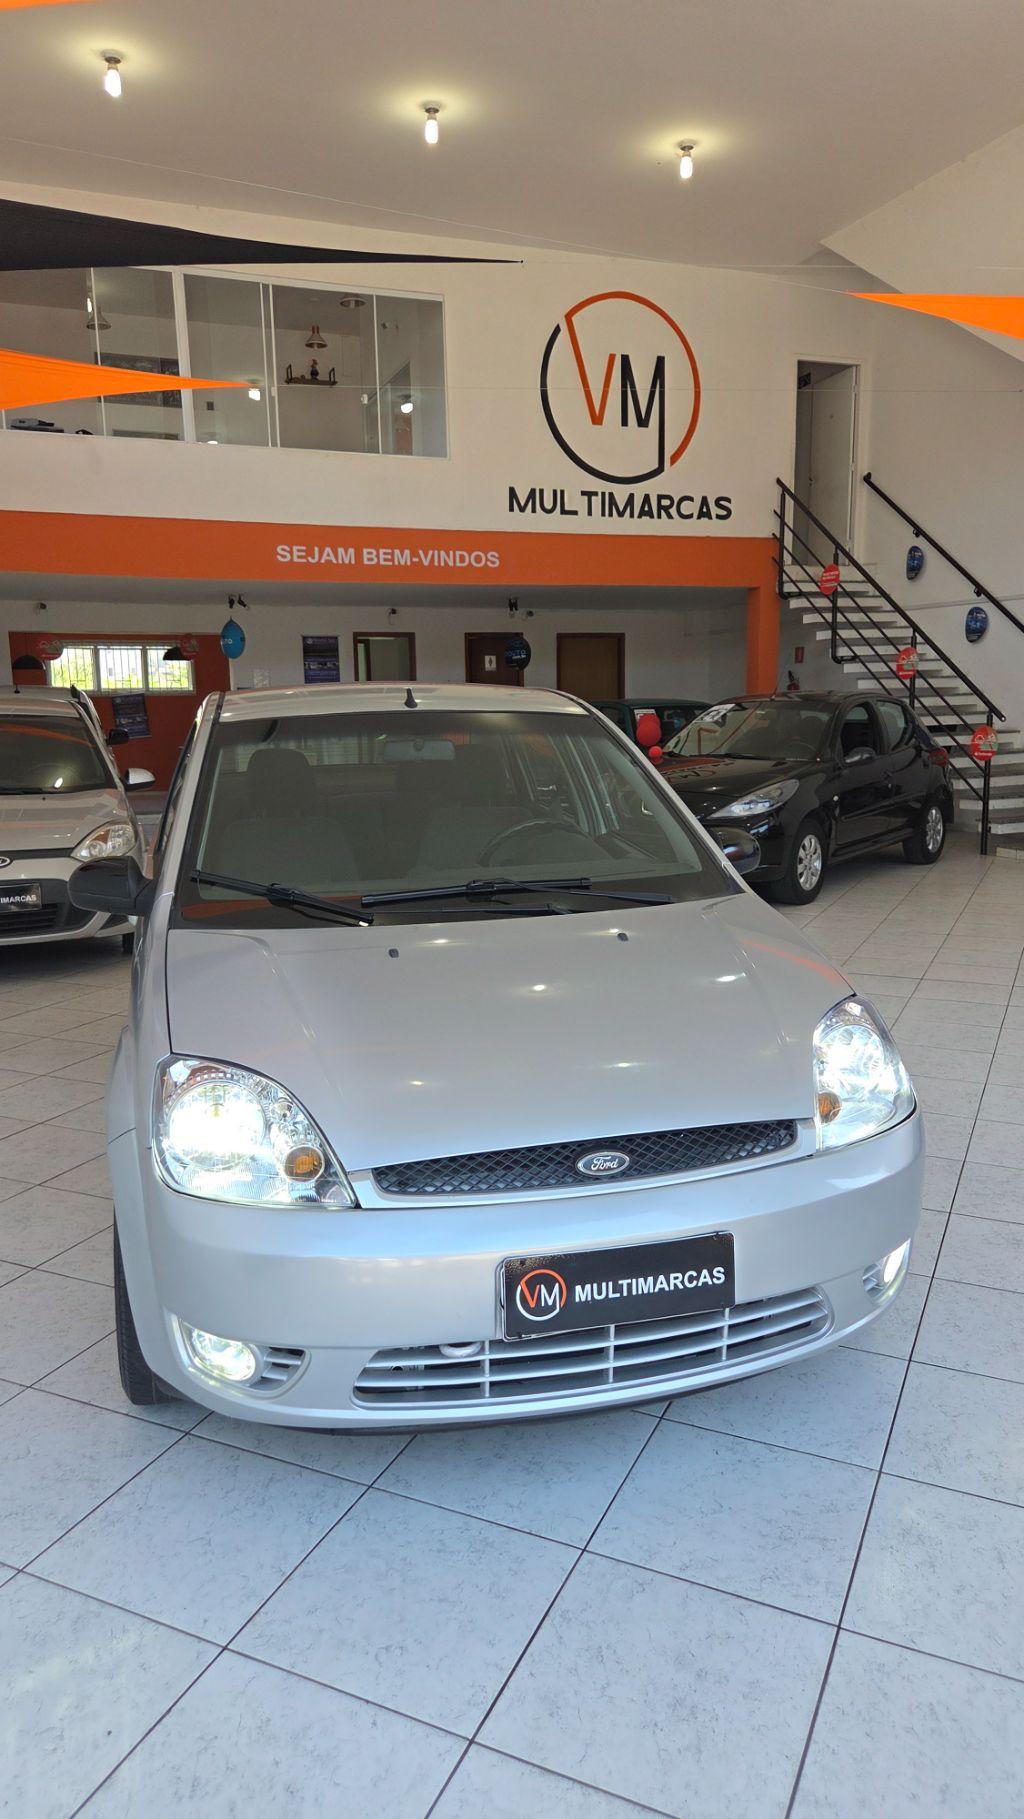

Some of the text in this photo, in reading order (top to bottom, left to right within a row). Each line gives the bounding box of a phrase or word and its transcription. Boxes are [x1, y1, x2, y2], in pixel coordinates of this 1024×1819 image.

[508, 486, 733, 520] MULTIMARCAS
[276, 545, 500, 568] SEJAM BEM-VINDOS
[591, 1156, 619, 1170] Ford
[575, 1266, 726, 1303] MULTIMARCAS
